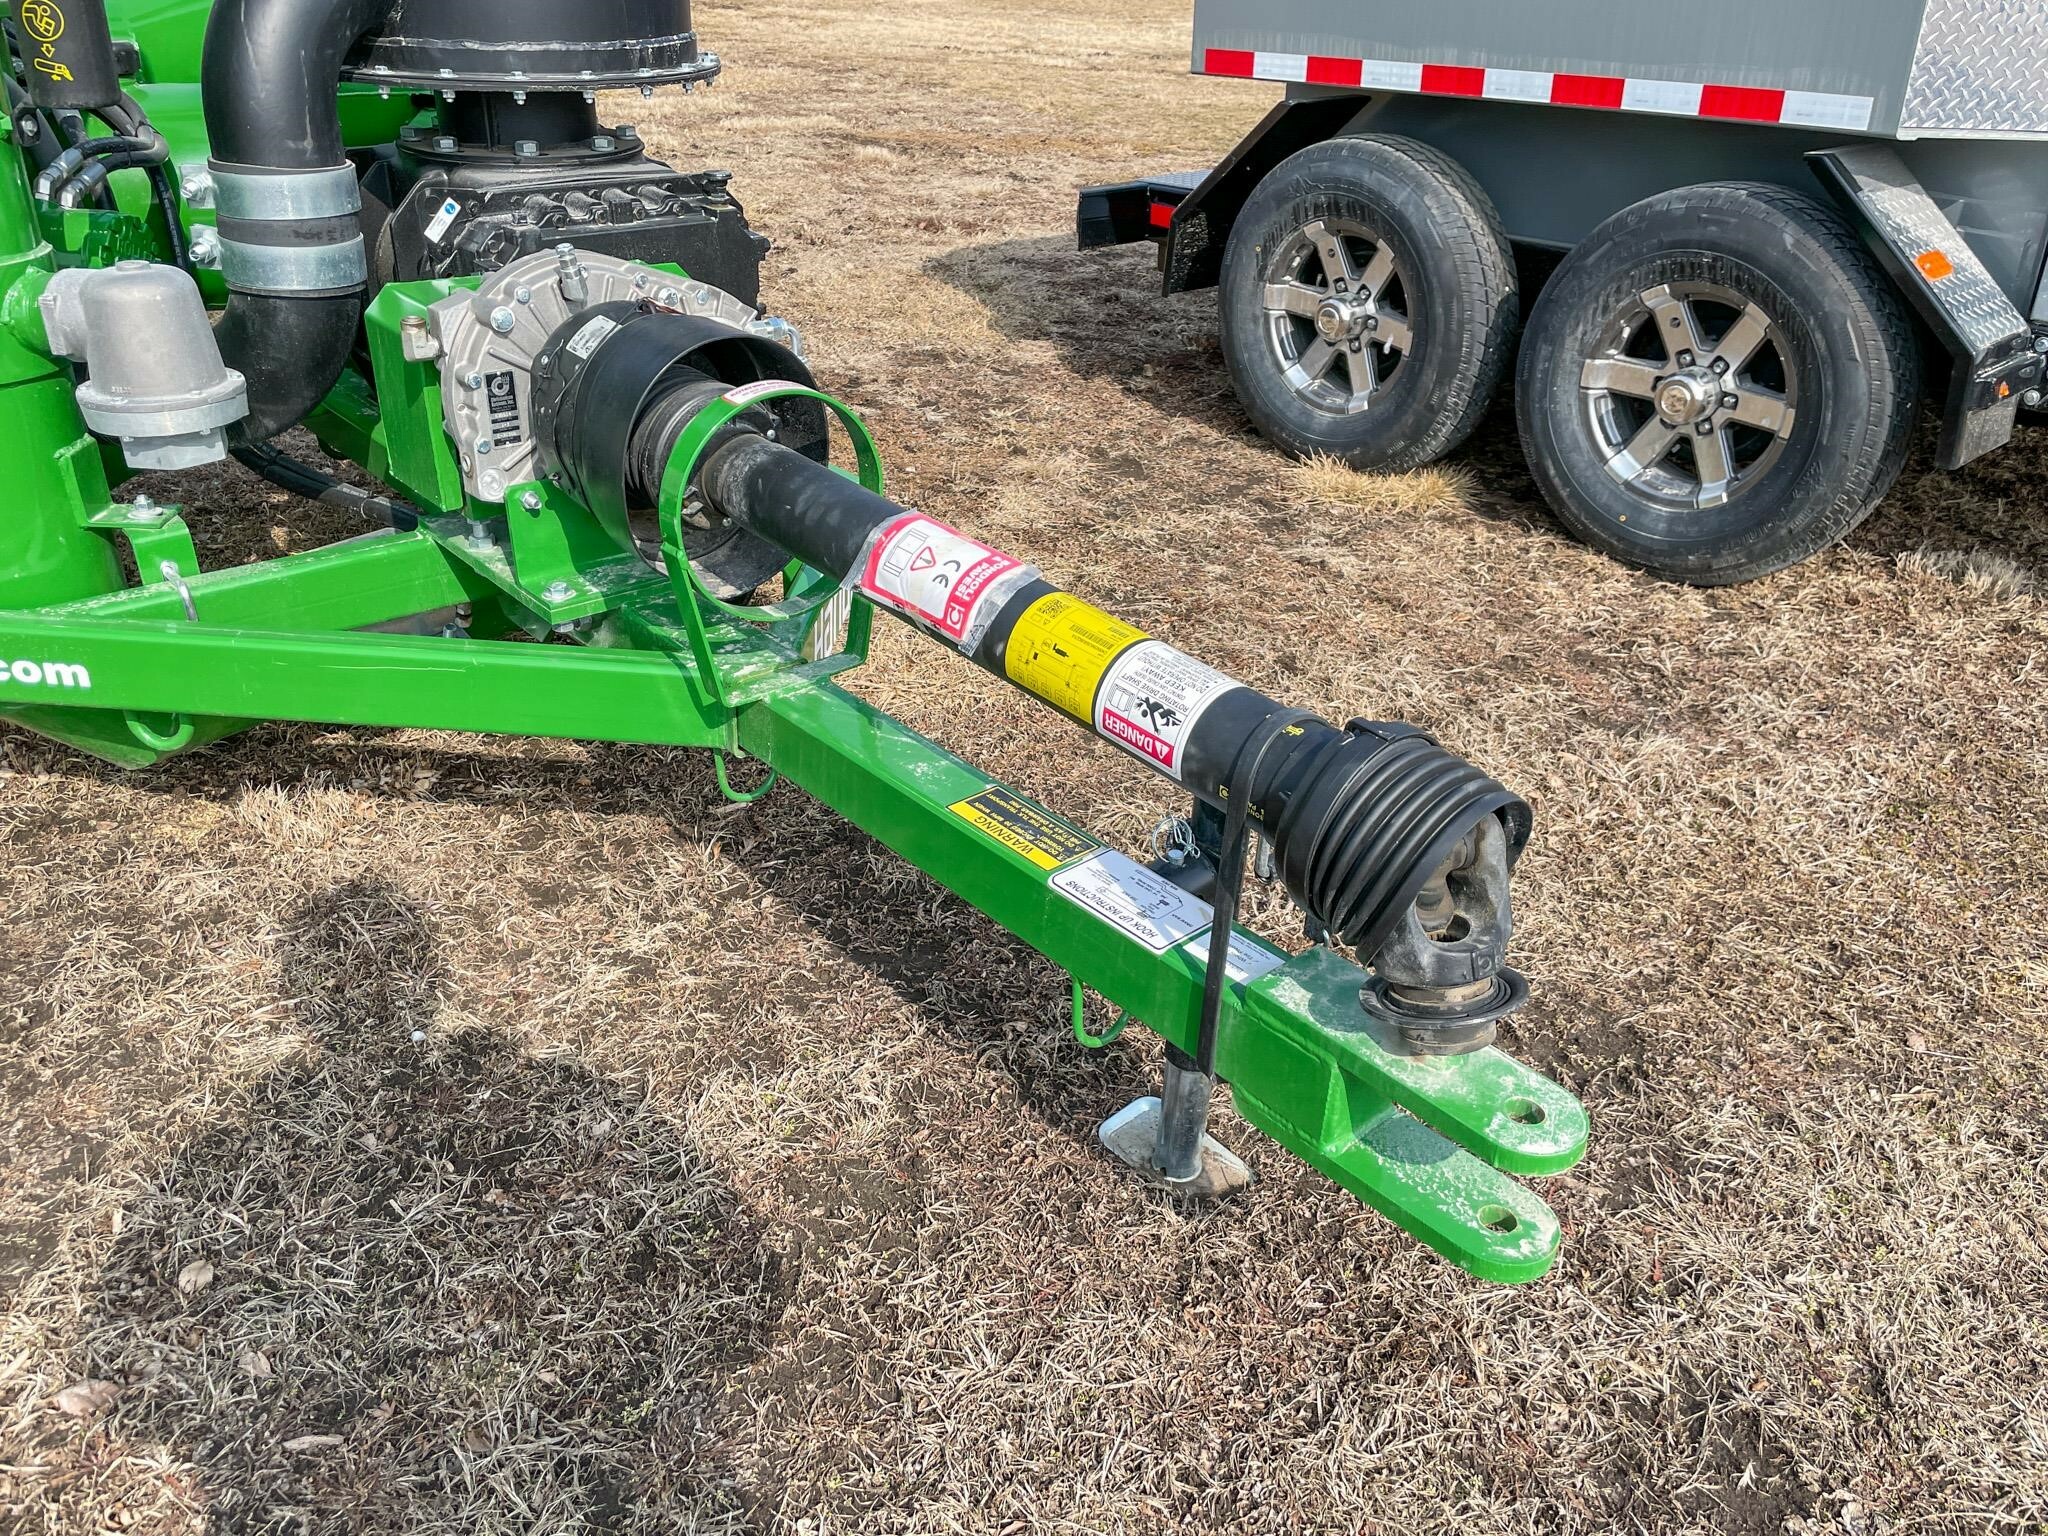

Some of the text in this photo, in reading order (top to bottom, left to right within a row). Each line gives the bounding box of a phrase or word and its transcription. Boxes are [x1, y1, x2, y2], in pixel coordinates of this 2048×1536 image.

[955, 561, 988, 597] PAVESI
[1120, 671, 1189, 713] ROTATING DRIVE SHAFT
[1163, 677, 1186, 692] KEEP
[1103, 712, 1153, 753] DANGER
[972, 813, 1034, 855] WARNING
[1050, 832, 1067, 843] NOT
[1064, 878, 1121, 915] INSTRUCTIONS
[1116, 911, 1133, 923] UP
[1129, 920, 1158, 939] HOOK
